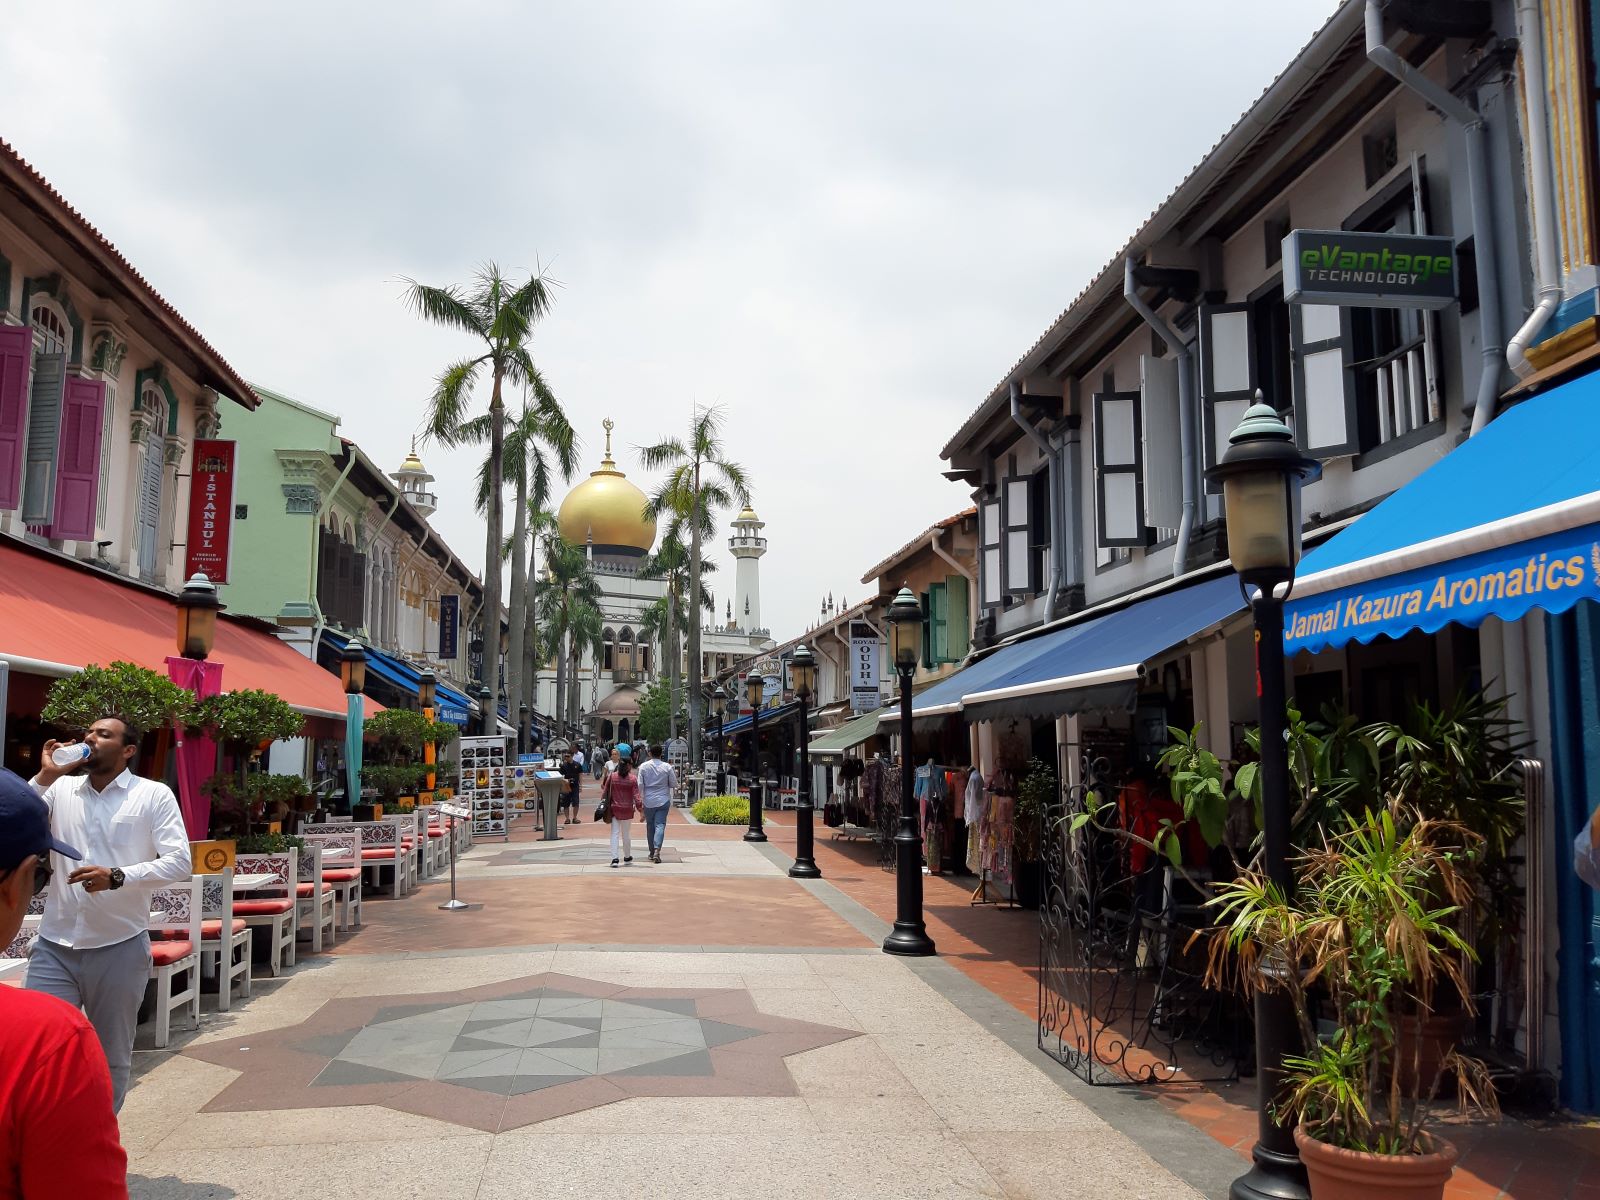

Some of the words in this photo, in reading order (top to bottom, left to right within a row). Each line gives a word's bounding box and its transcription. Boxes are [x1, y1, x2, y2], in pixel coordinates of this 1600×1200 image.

[1301, 244, 1451, 281] eVantage
[1308, 269, 1418, 285] TECHNOLOGY
[202, 474, 217, 548] ISTANBUL
[1285, 600, 1341, 640] Jamal
[1343, 589, 1422, 627] Kazura
[1426, 553, 1585, 612] Aromatics
[859, 645, 871, 679] OUDH
